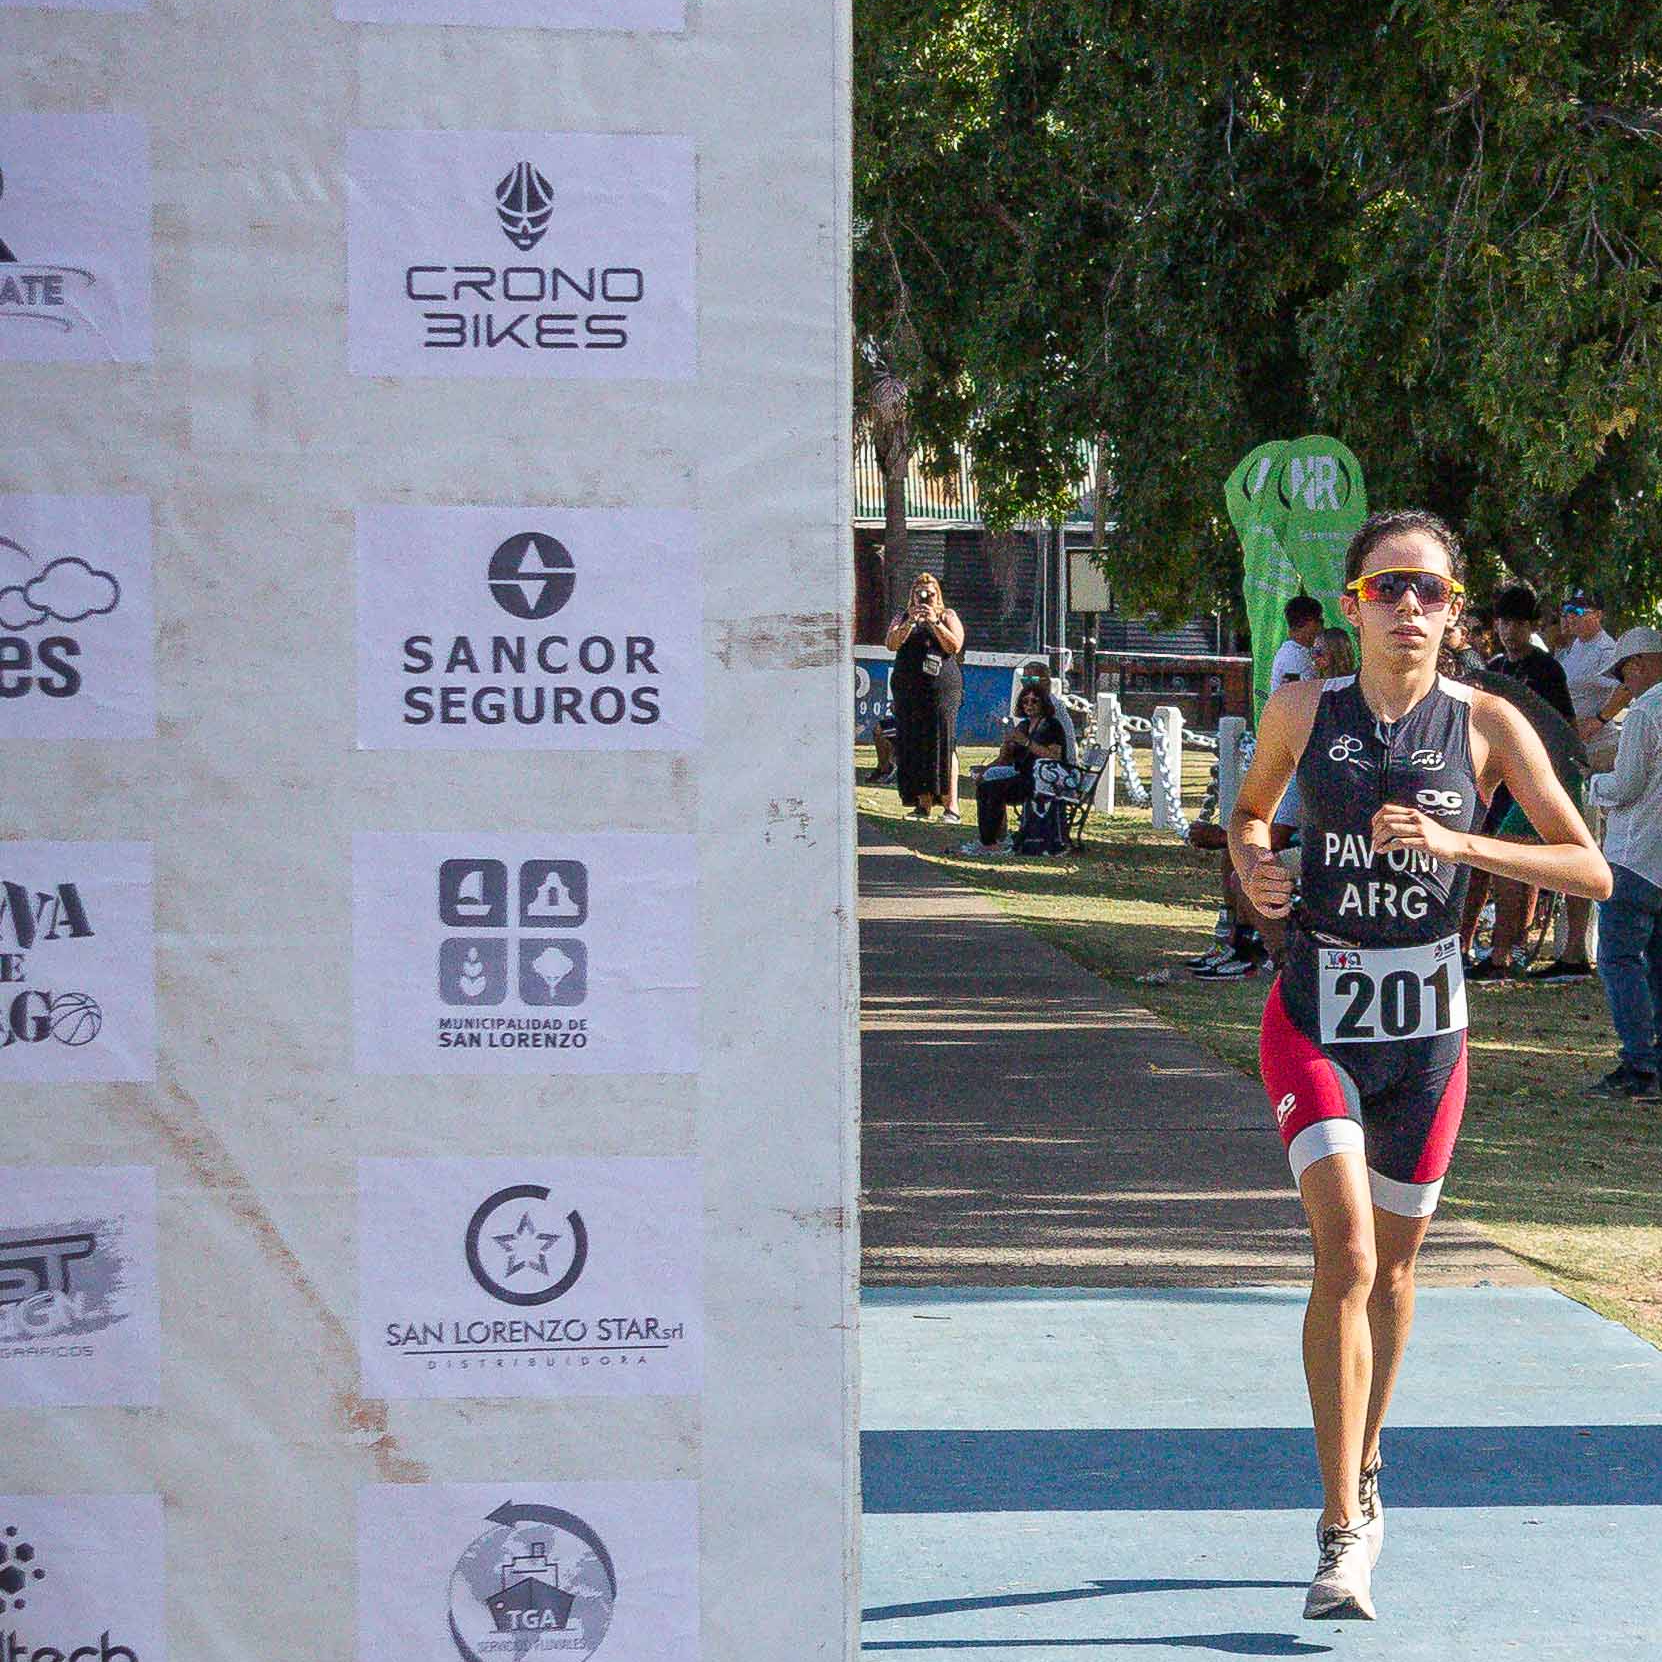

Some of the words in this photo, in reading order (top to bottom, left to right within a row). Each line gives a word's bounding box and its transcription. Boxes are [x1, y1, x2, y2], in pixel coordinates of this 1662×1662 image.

[406, 266, 644, 302] CRONO
[424, 313, 628, 348] BIKES
[403, 635, 661, 674] SANCOR
[403, 686, 661, 725] SEGUROS
[1335, 963, 1451, 1039] 201
[439, 1018, 563, 1031] MUNICIPALIDAD
[568, 1019, 588, 1030] DE
[439, 1032, 482, 1048] SAN
[488, 1032, 588, 1048] LORENZO
[386, 1321, 444, 1347] SAN
[455, 1318, 588, 1345] LORENZO
[597, 1317, 662, 1341] STAR
[428, 1355, 647, 1370] DISTRIBUIDORA
[505, 1609, 559, 1629] TGA
